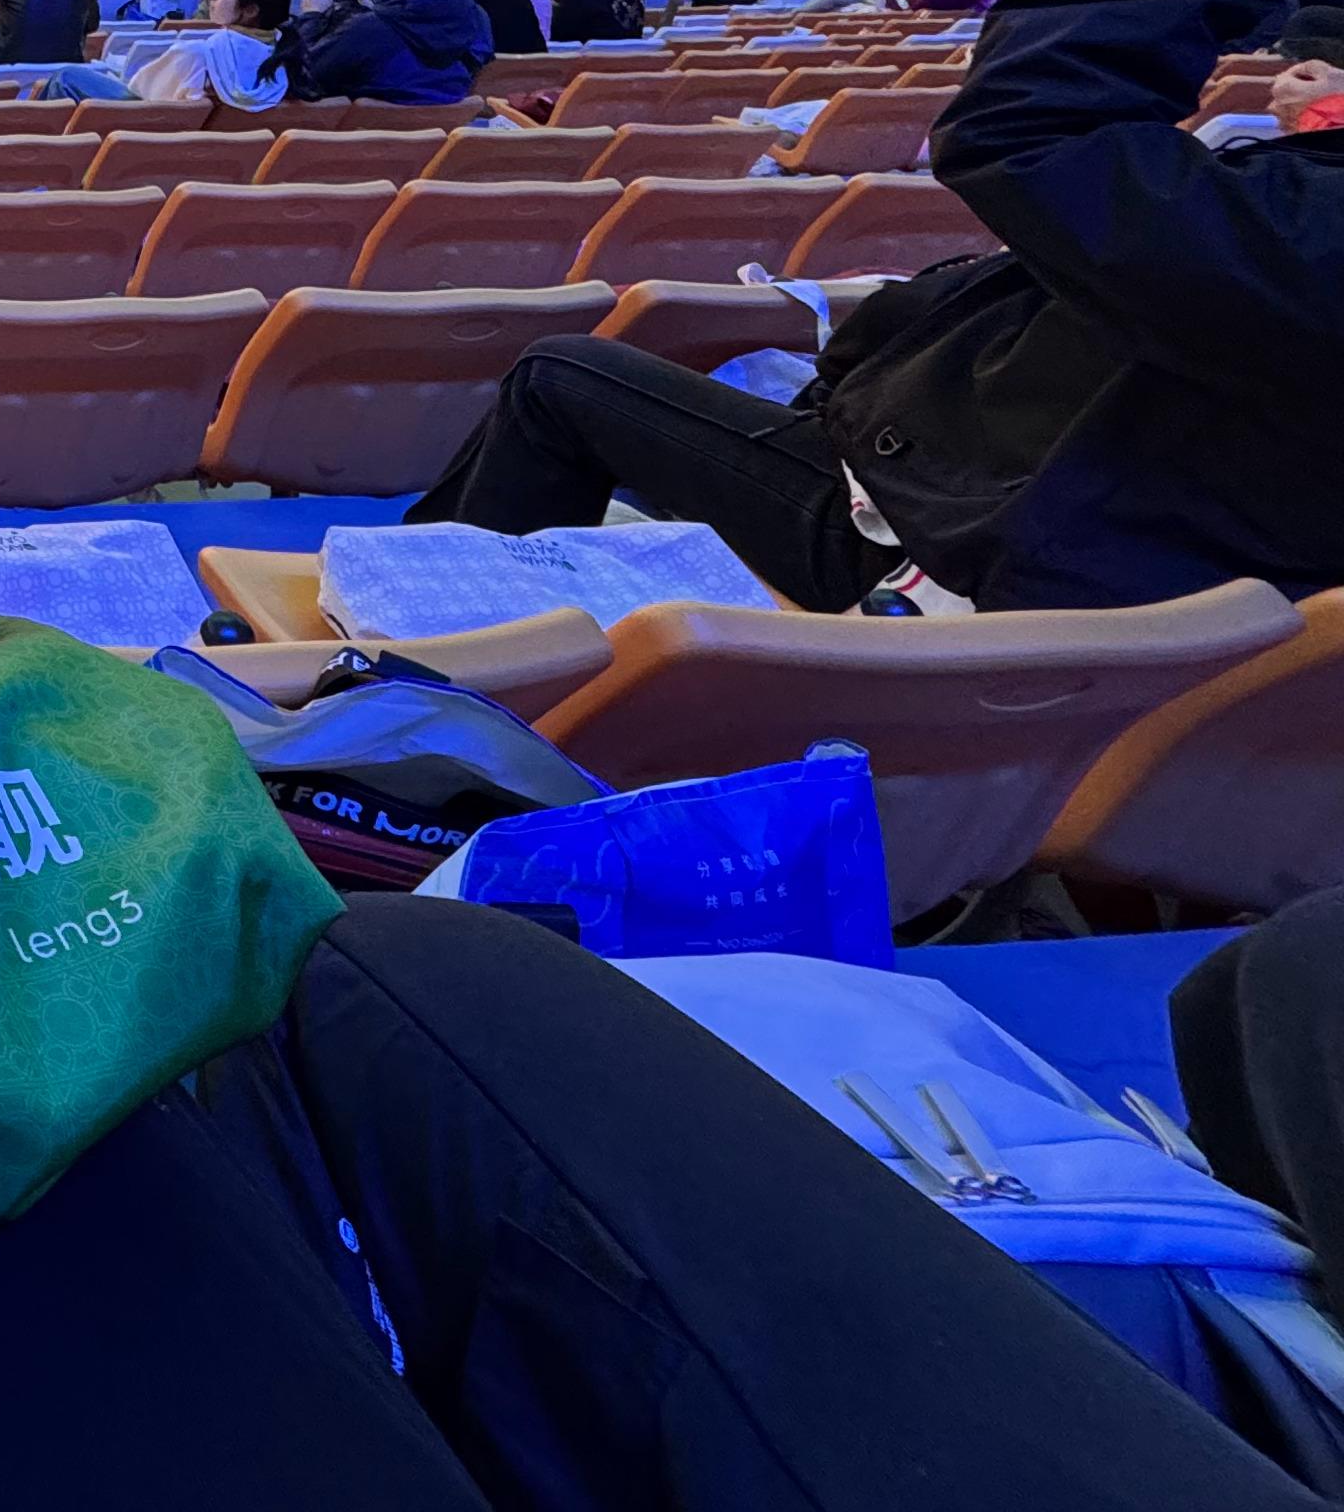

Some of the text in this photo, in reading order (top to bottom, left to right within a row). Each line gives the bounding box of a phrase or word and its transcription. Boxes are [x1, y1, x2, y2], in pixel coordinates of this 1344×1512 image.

[293, 786, 363, 822] FOR
[374, 810, 468, 847] MOR
[9, 890, 143, 964] leng3
